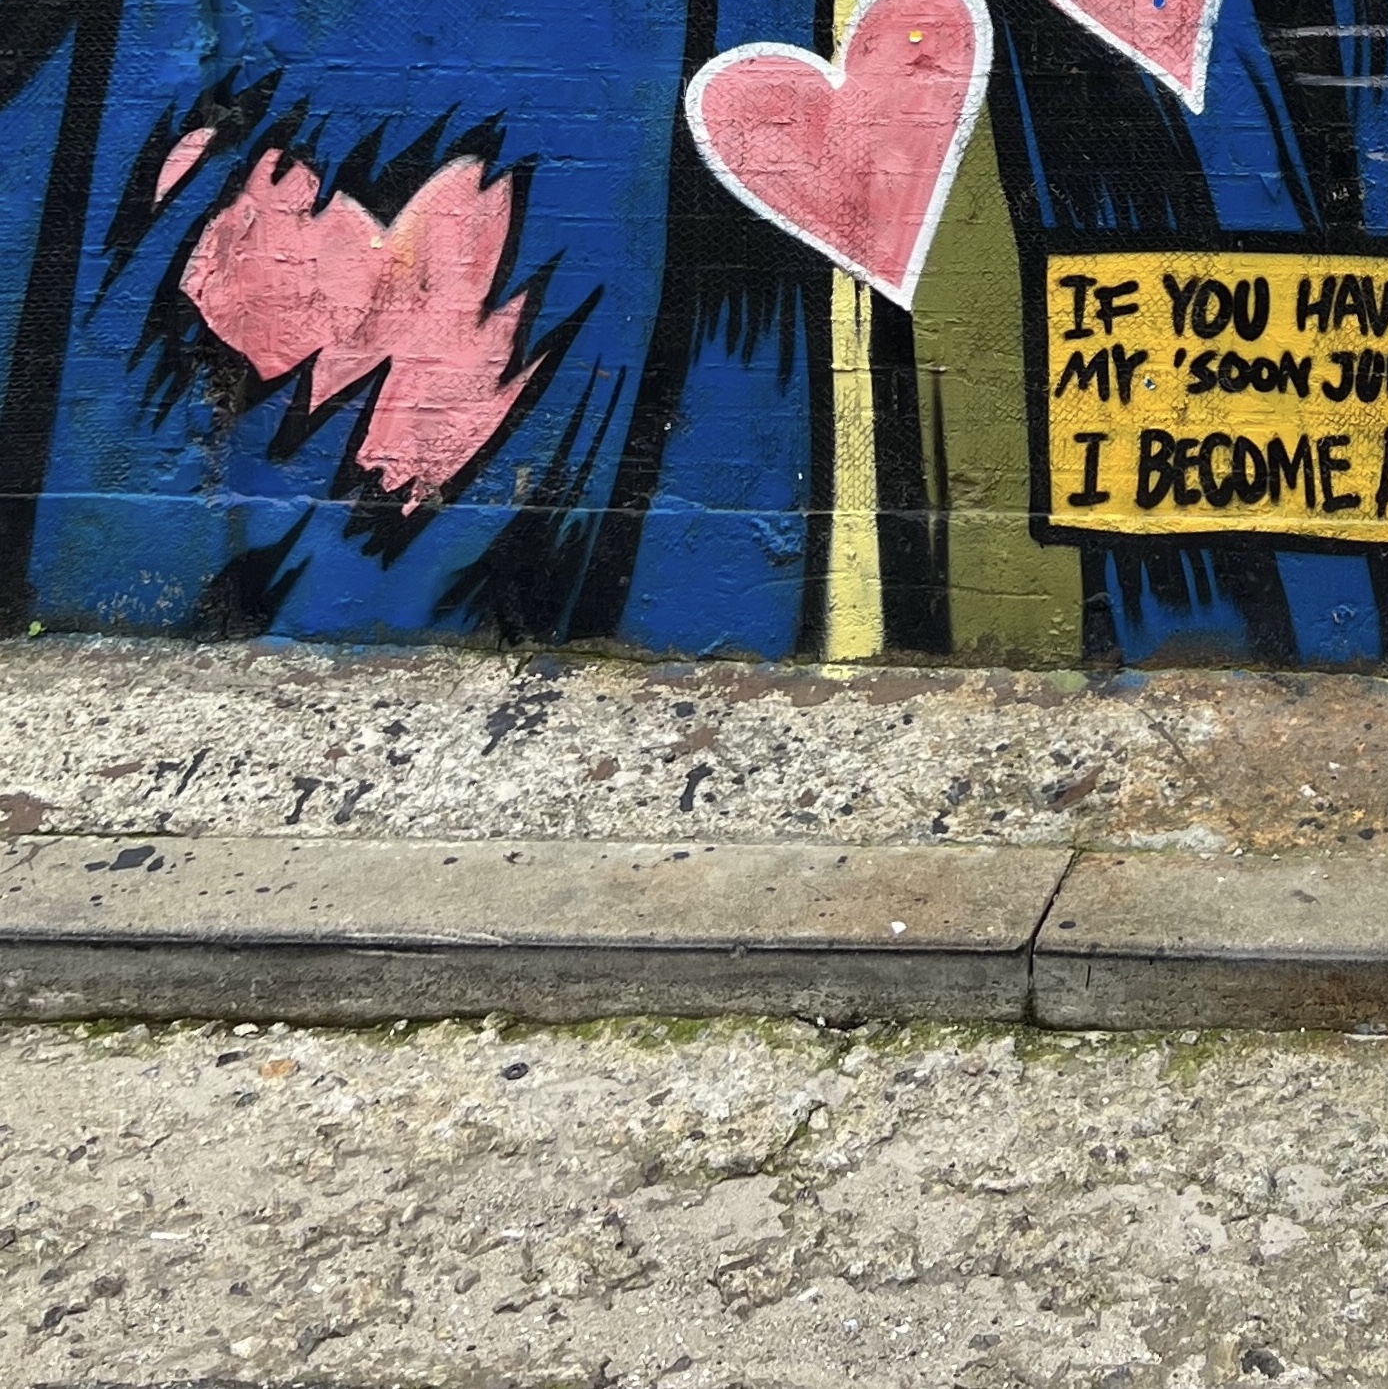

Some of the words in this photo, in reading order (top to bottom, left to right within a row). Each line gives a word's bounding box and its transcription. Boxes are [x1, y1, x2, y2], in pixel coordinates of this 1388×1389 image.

[1059, 275, 1139, 340] IF
[1163, 274, 1270, 341] YOU
[1055, 345, 1147, 404] MY
[1068, 432, 1128, 506] I
[1135, 429, 1361, 510] BECOME
